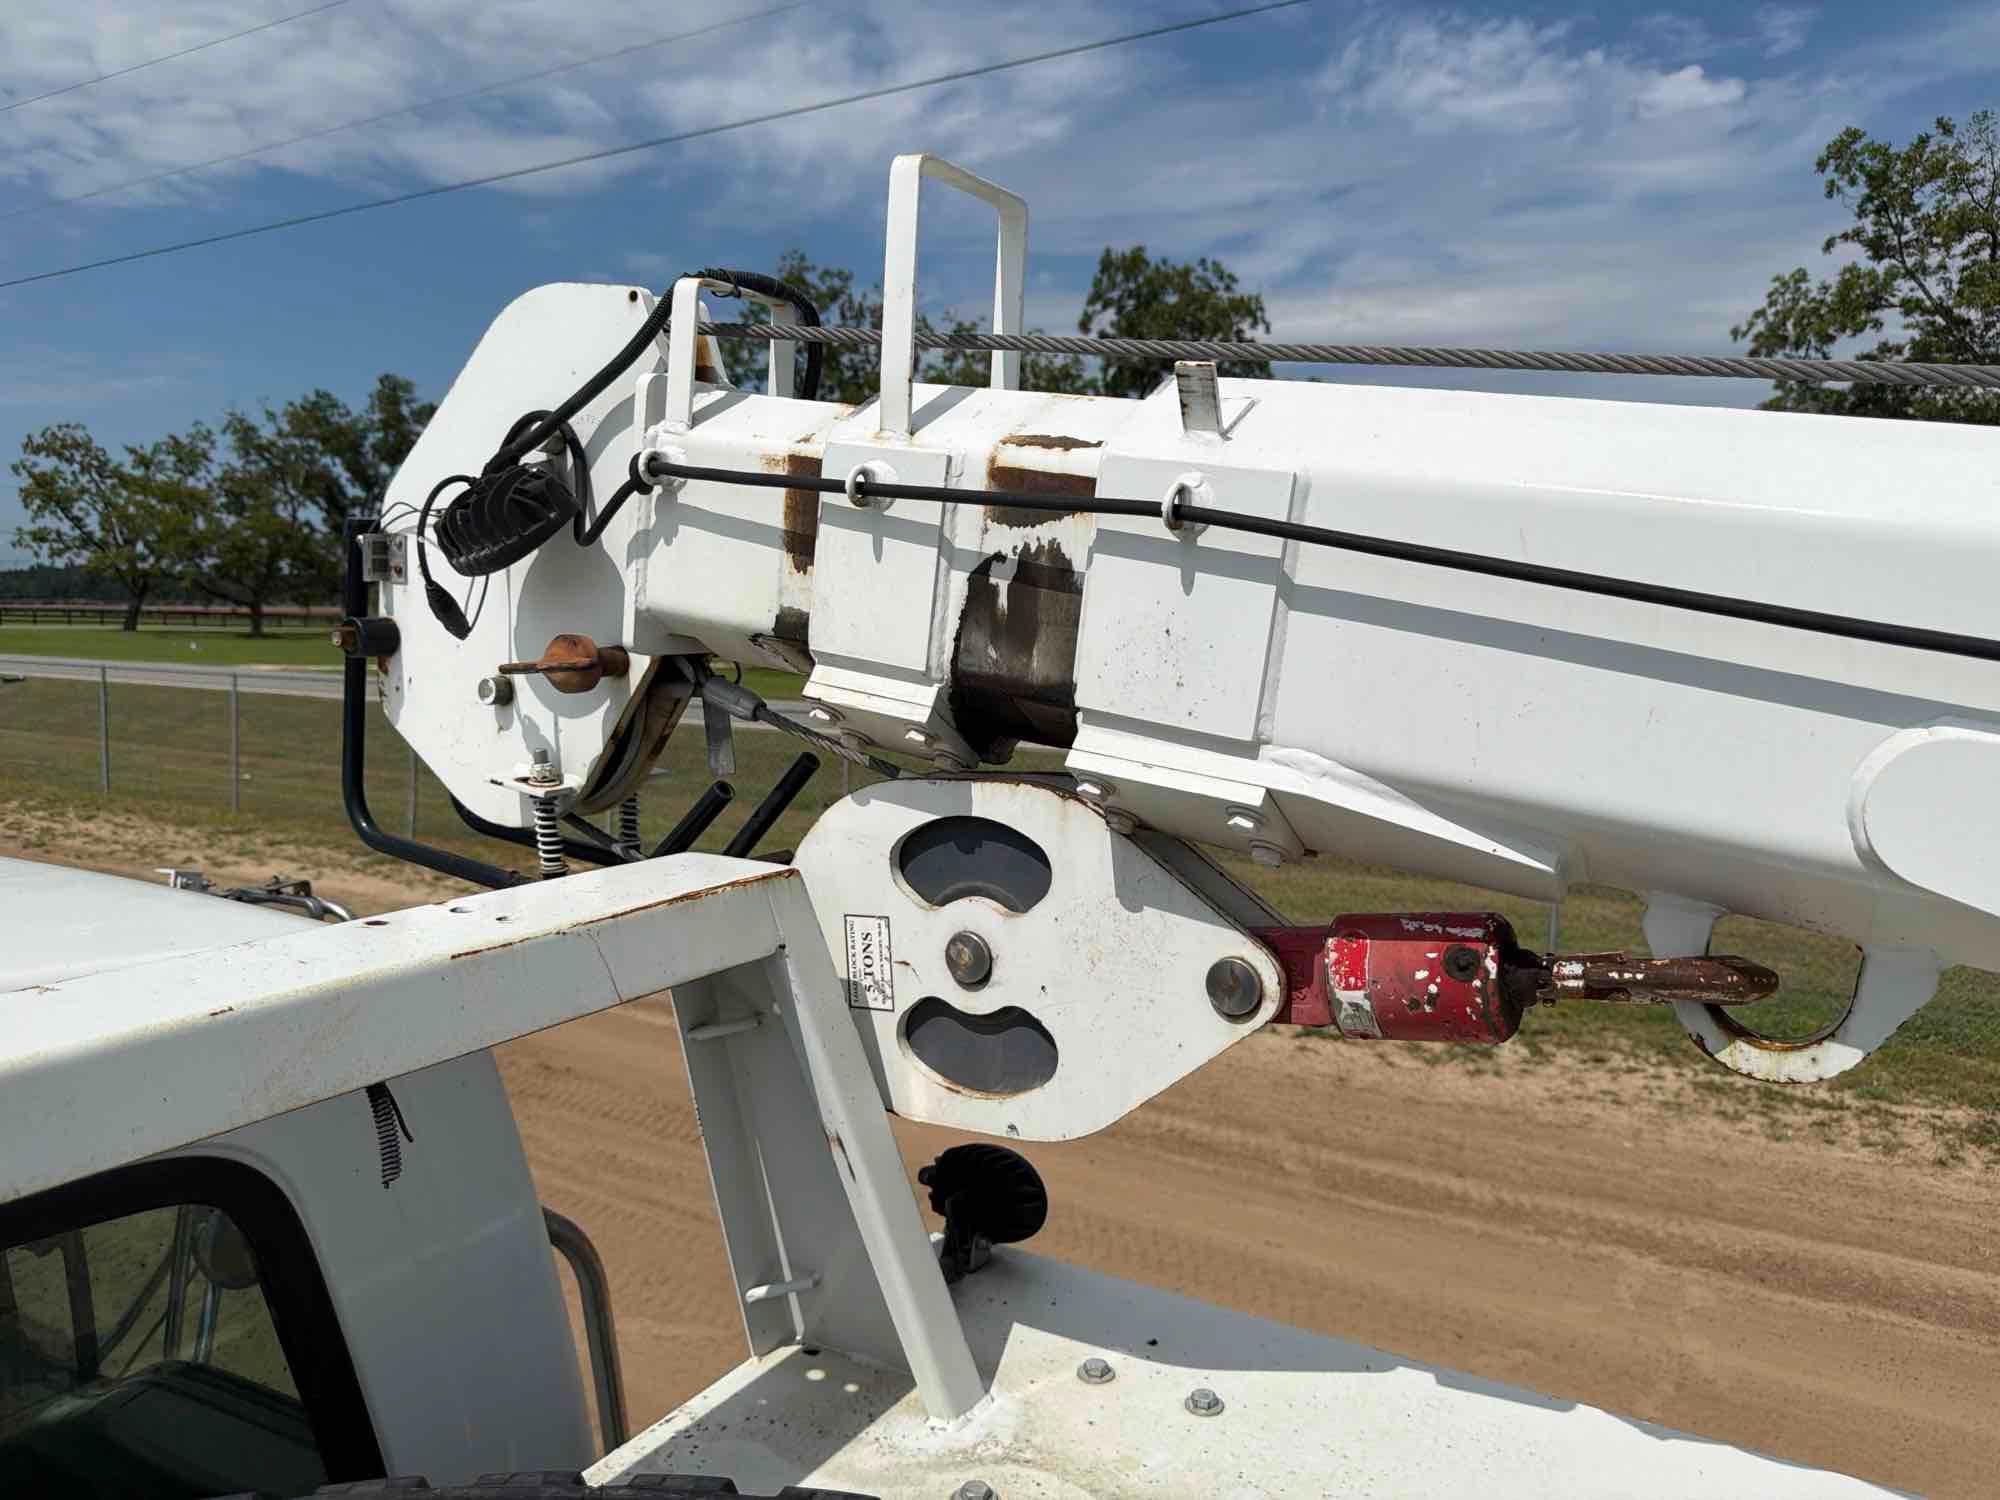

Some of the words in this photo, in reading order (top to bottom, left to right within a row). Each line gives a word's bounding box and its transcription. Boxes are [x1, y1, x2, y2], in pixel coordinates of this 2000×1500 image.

[849, 920, 857, 950] RATING
[861, 931, 874, 980] TONS
[864, 983, 875, 994] 5
